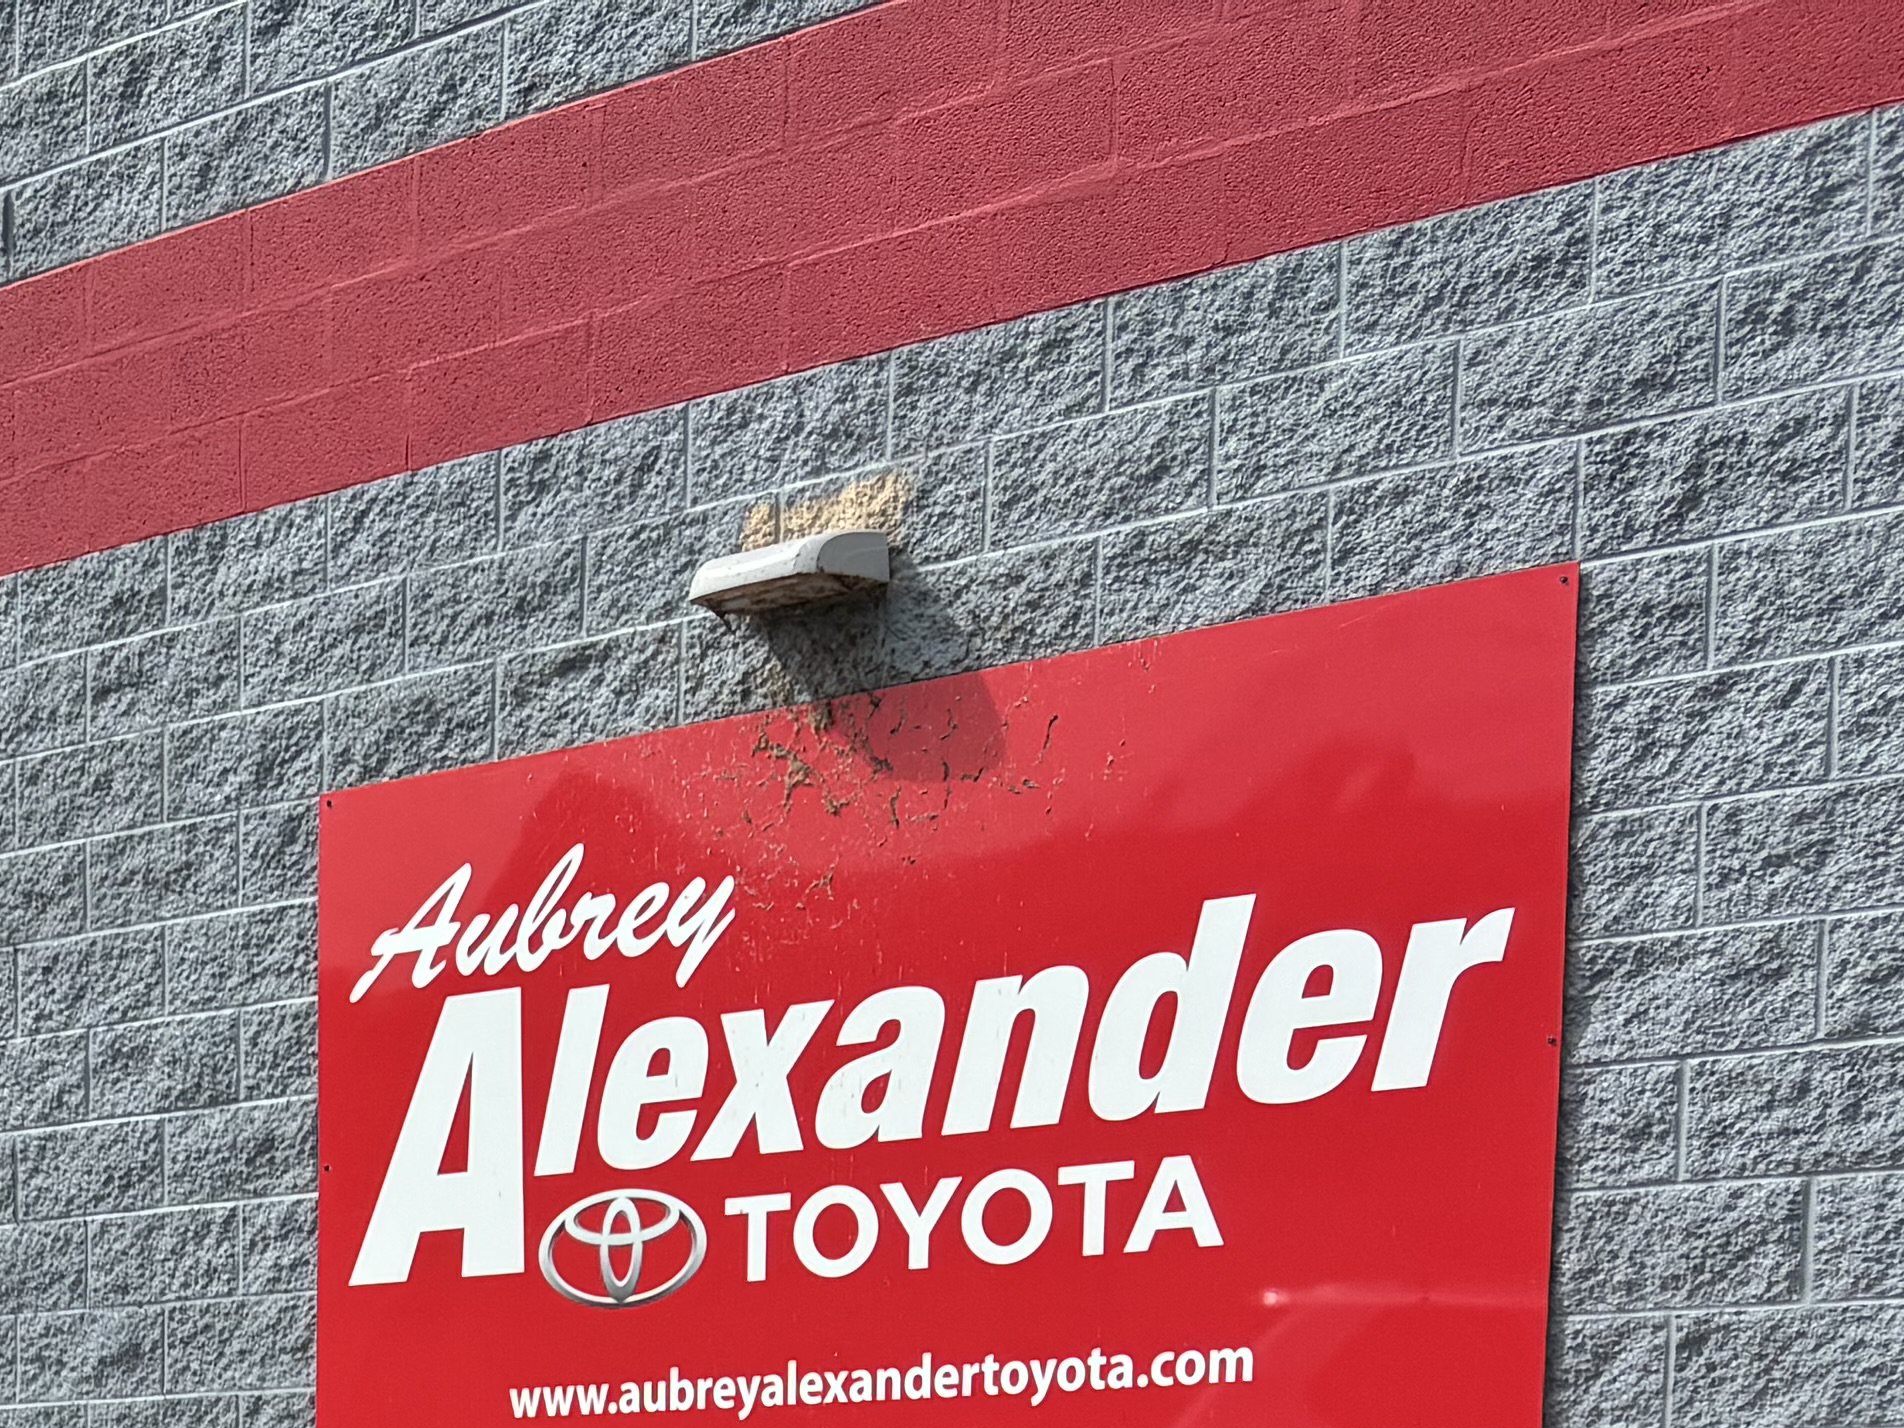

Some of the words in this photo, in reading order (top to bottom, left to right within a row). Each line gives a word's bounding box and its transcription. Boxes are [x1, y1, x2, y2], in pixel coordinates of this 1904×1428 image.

[349, 843, 736, 1004] Aubrey
[348, 893, 1516, 1287] Alexander
[724, 1154, 1224, 1282] TOYOTA
[509, 1346, 1254, 1421] www.aubreyalexandertoyota.com
